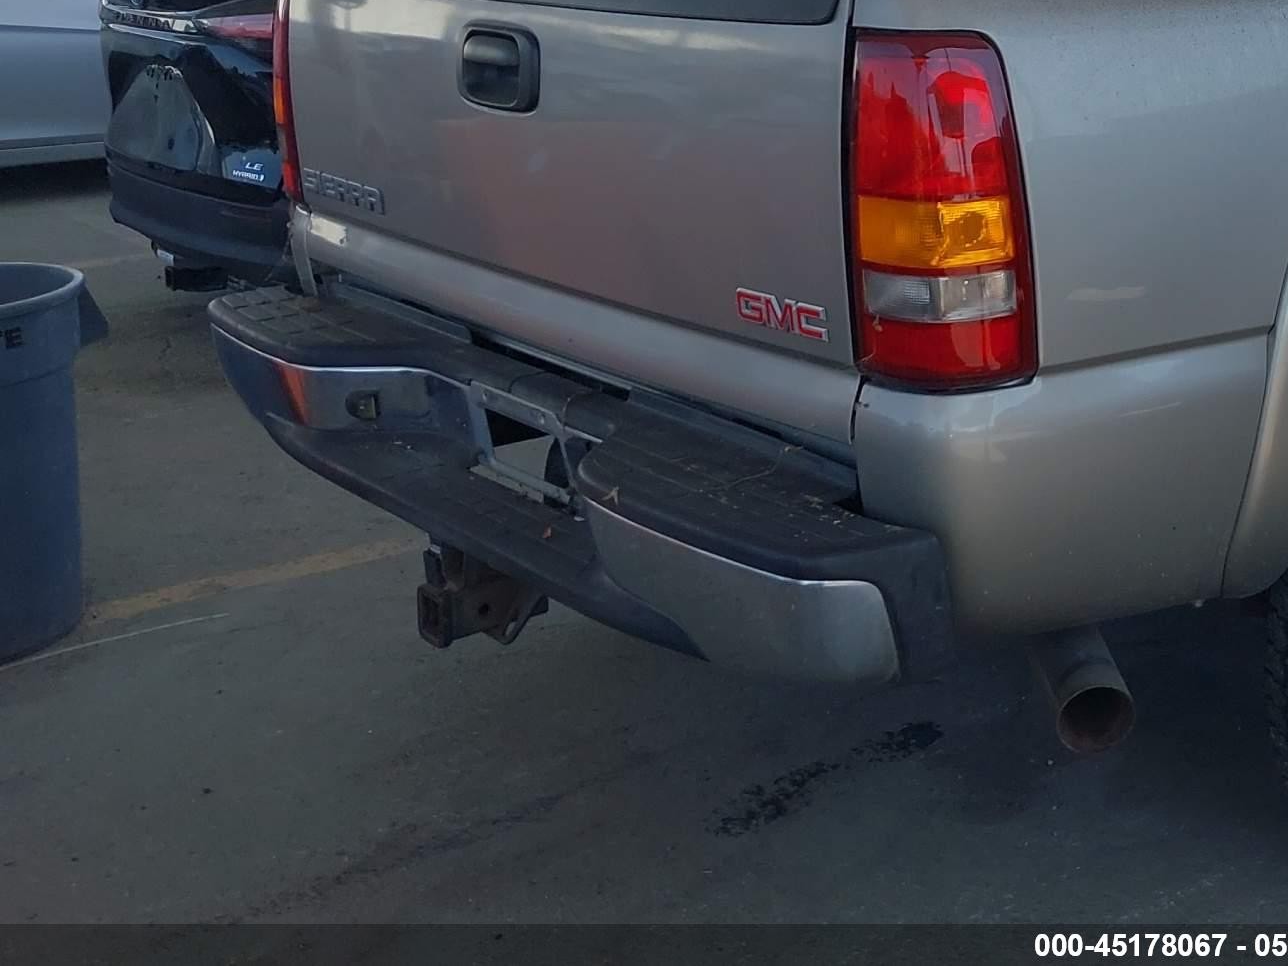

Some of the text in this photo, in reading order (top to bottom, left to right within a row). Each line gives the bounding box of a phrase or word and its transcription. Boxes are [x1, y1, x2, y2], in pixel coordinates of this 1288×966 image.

[245, 162, 264, 171] LE
[303, 167, 385, 215] SIERRA
[736, 287, 829, 343] GMC
